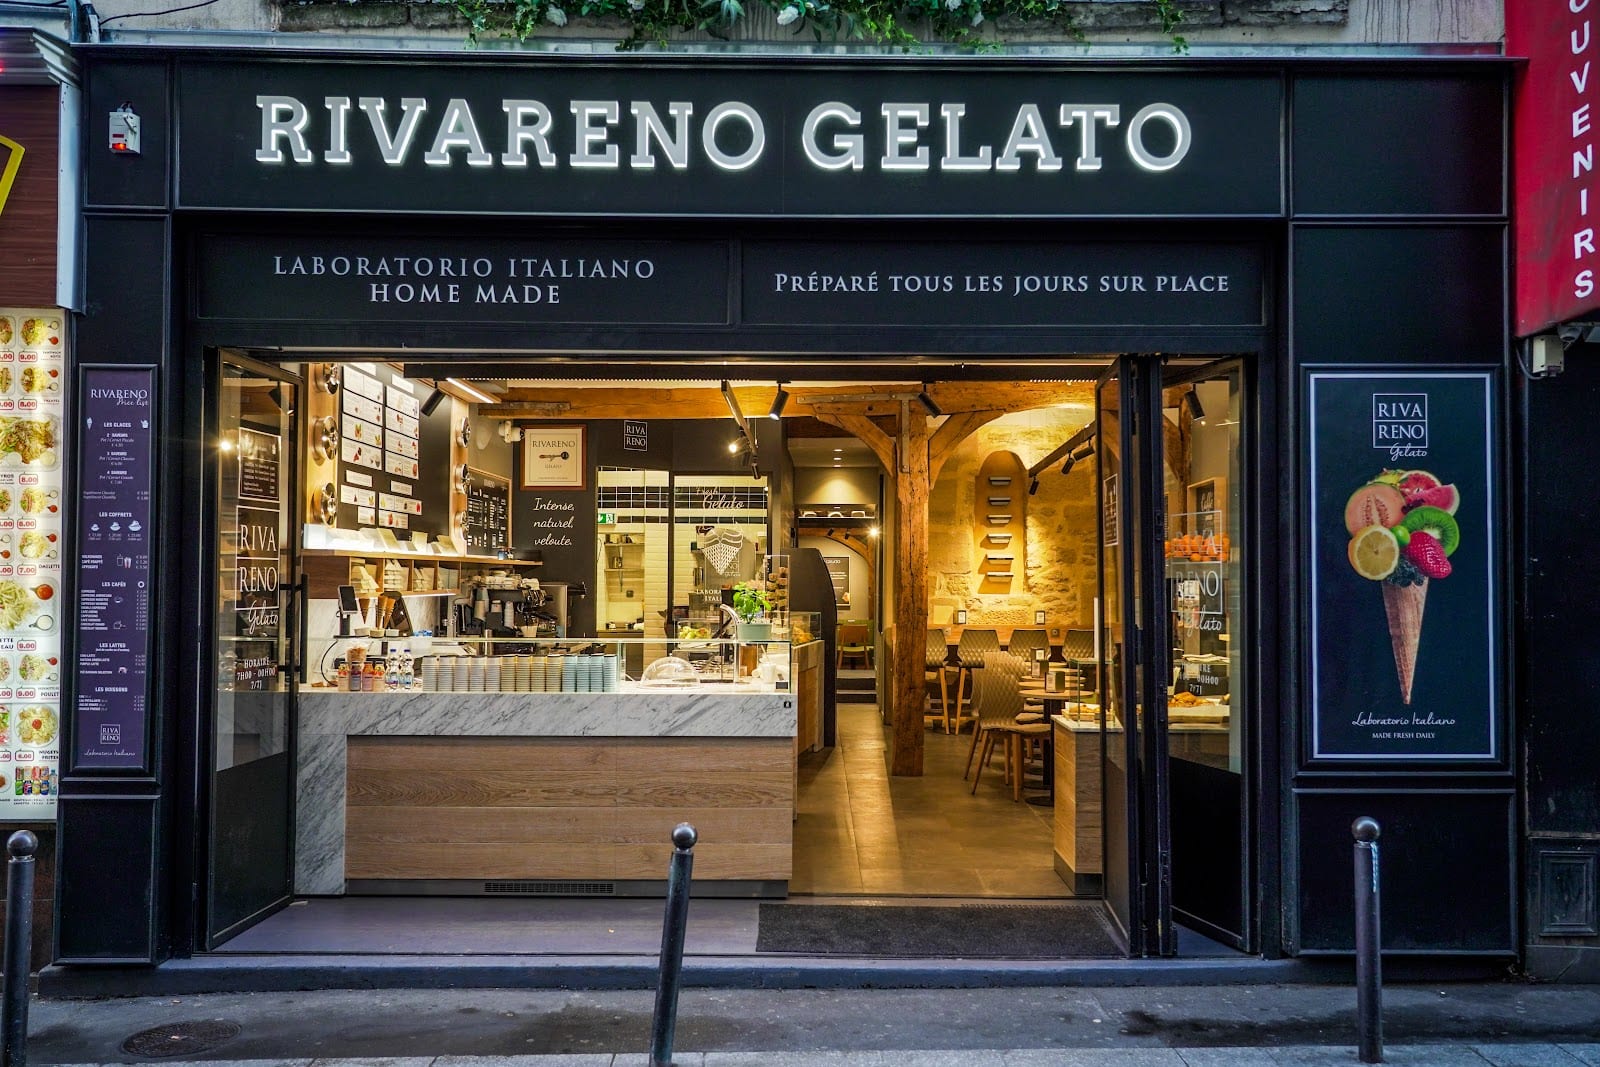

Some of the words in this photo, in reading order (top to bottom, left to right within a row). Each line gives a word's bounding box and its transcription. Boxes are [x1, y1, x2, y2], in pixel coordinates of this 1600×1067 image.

[255, 95, 766, 171] RIVARENO
[801, 101, 1193, 172] GELATO
[274, 256, 493, 277] LABORATORIO
[508, 258, 656, 279] ITALIANO
[889, 275, 953, 292] TOUS
[965, 275, 1003, 292] LES
[1013, 275, 1088, 296] JOURS
[1099, 275, 1147, 292] SUR
[1155, 275, 1229, 292] PLACE
[369, 283, 461, 303] HOME
[475, 284, 561, 304] MADE
[91, 388, 148, 399] RIVARENO
[116, 397, 134, 406] Price
[1378, 403, 1423, 417] RIVA
[626, 424, 646, 435] RIVA
[1378, 424, 1425, 439] RENO
[532, 440, 576, 448] RIVARENO
[626, 436, 646, 447] RENO
[1390, 442, 1428, 462] Gelato
[240, 524, 277, 552] RIVA
[239, 566, 278, 592] RENO
[248, 600, 279, 634] Gelato
[244, 656, 270, 668] HORAIRE
[1352, 711, 1410, 726] Laboratorio
[1412, 711, 1456, 726] Italiano
